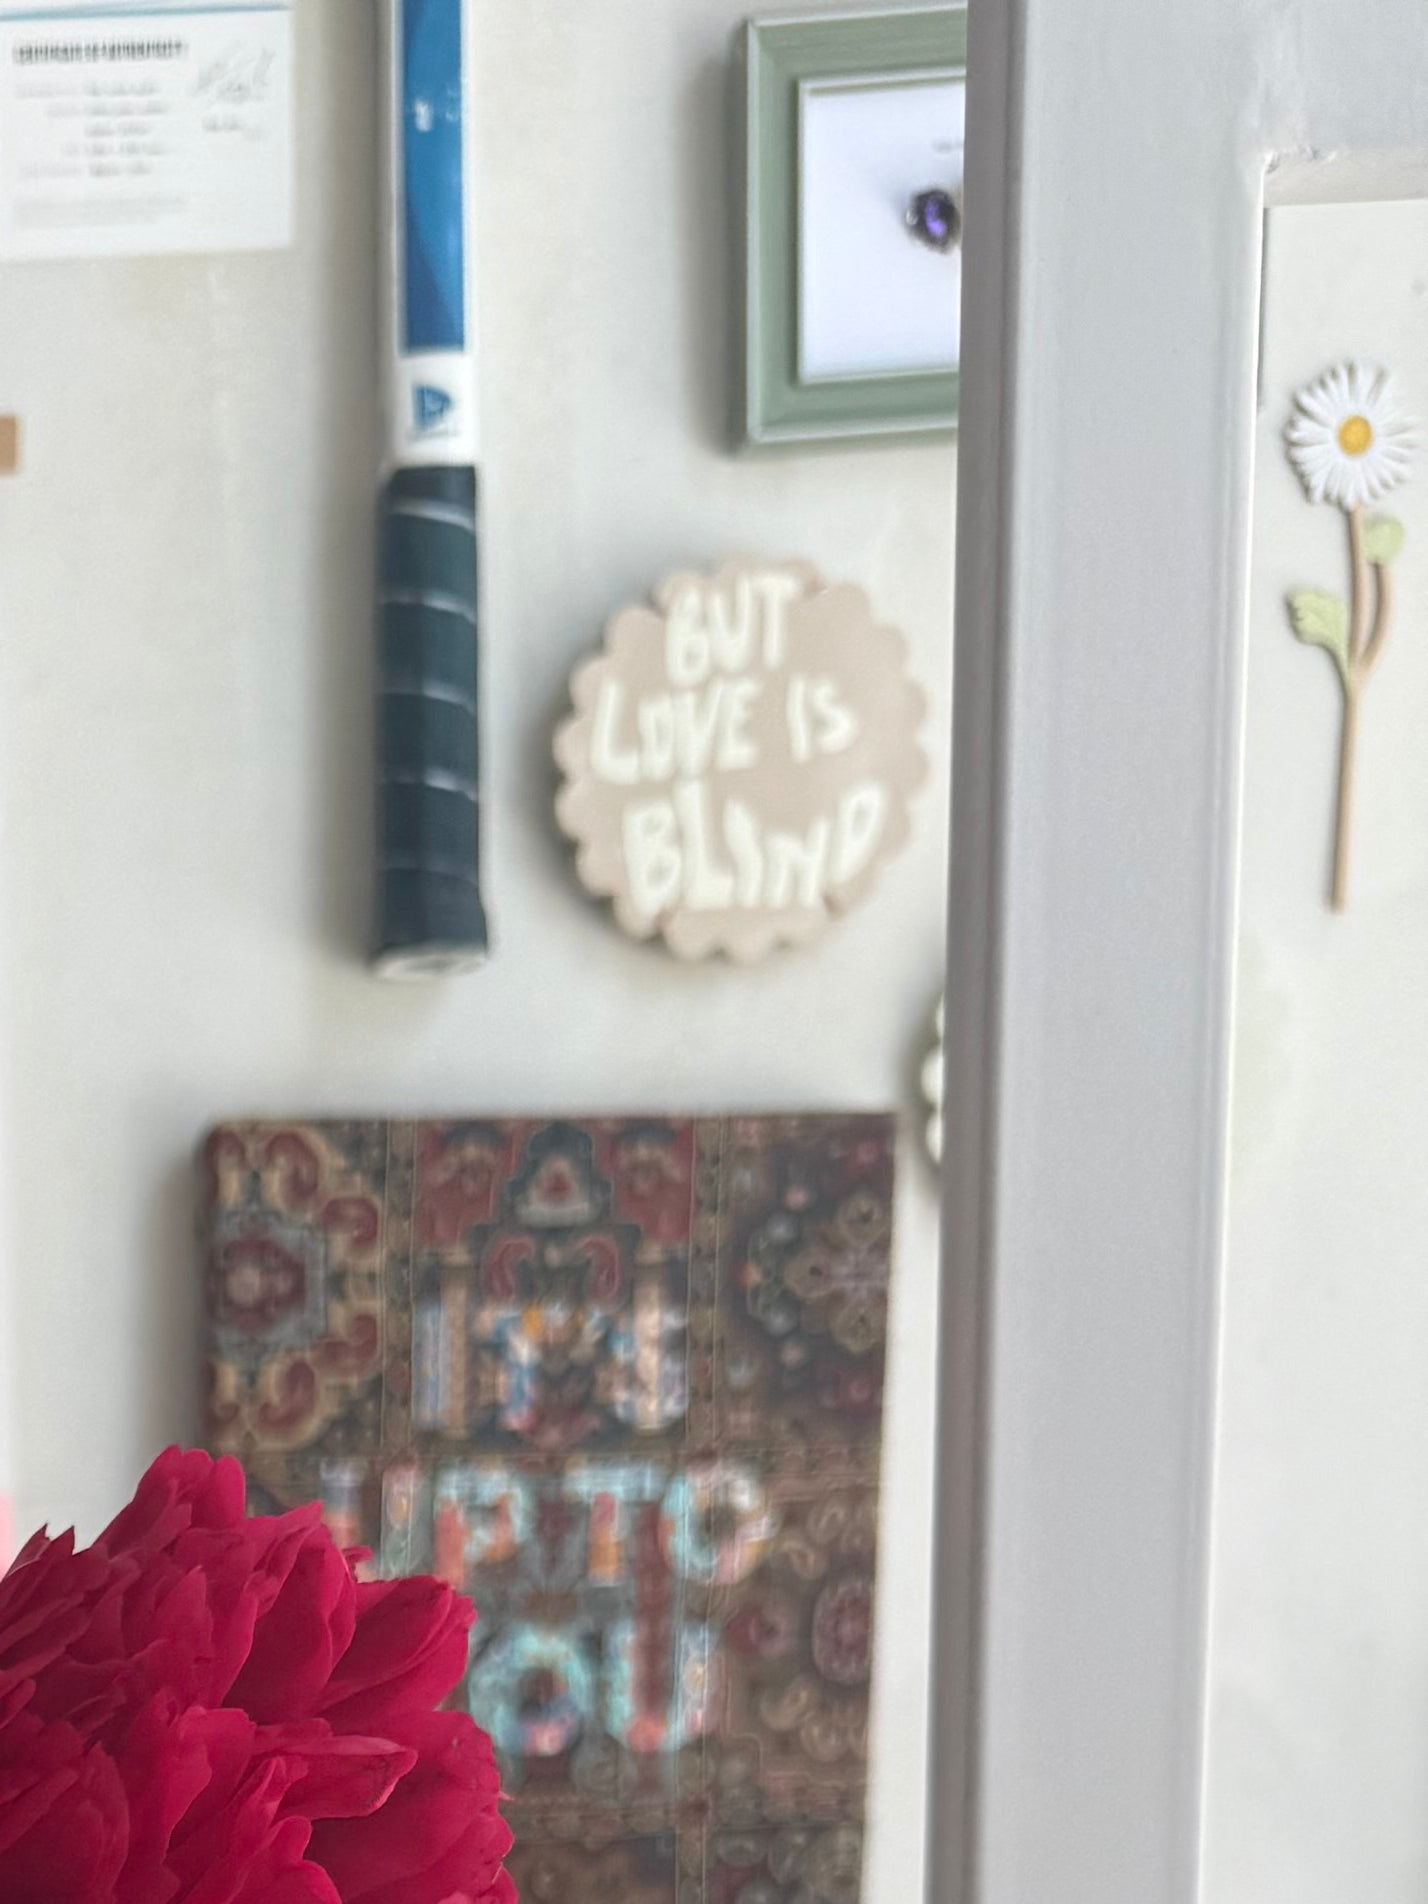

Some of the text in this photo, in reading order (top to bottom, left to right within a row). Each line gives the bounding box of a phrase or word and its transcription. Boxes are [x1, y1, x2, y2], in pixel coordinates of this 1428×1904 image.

[666, 573, 802, 687] BUT
[591, 672, 857, 785] LOVE IS
[623, 780, 886, 915] BLIND
[470, 1614, 717, 1756] OU
